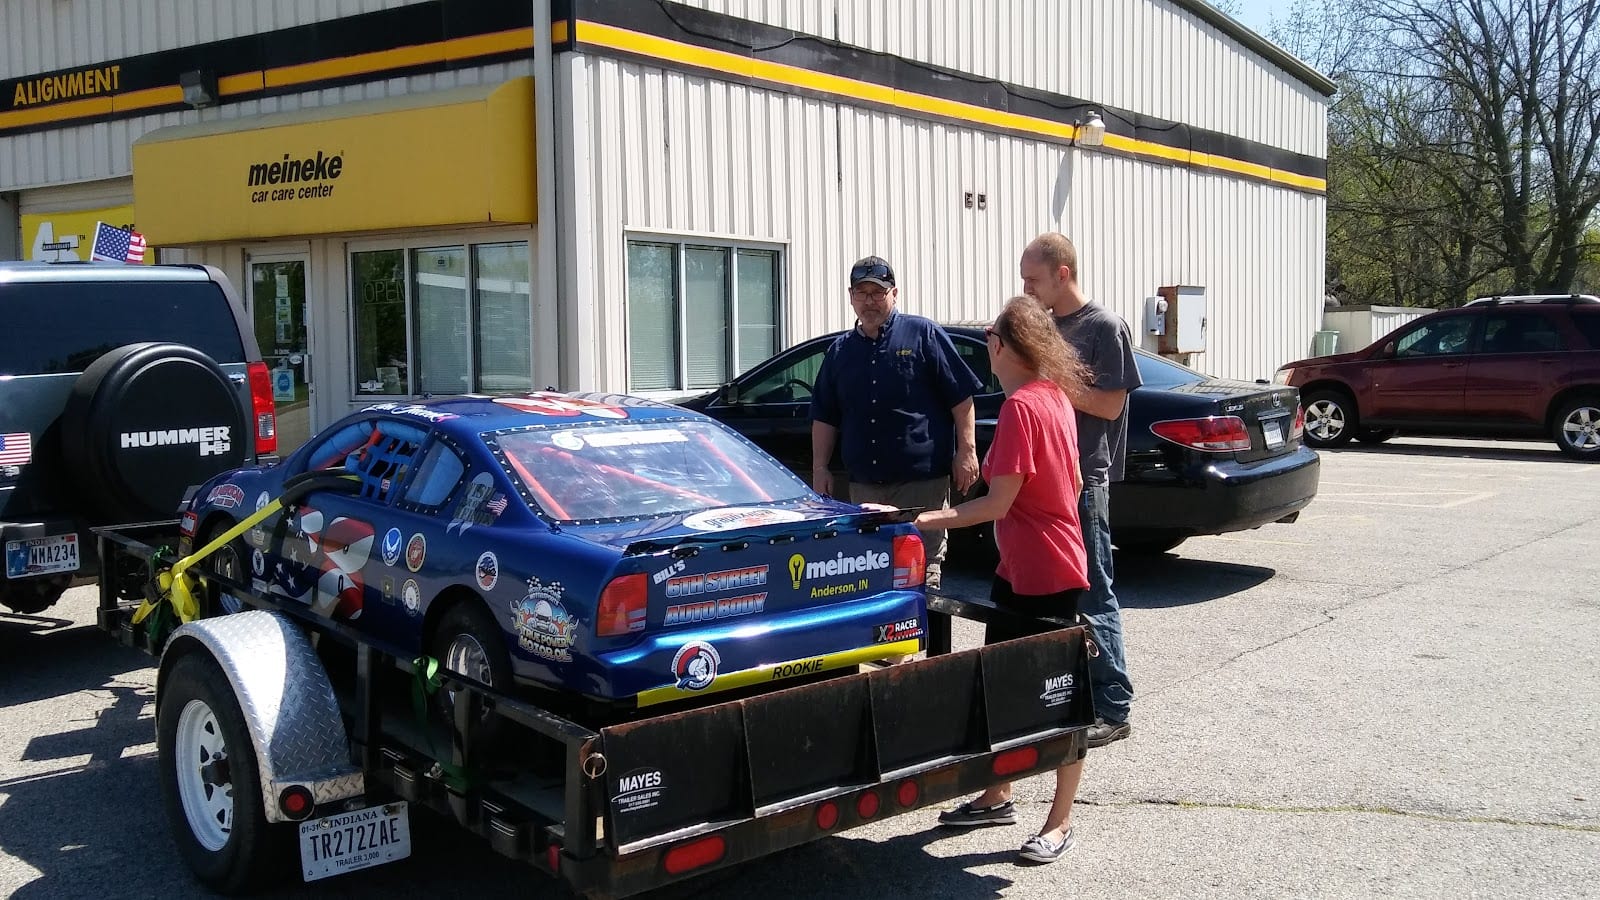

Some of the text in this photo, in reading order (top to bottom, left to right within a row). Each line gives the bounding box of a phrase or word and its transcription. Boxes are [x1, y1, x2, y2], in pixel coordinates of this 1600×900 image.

[13, 65, 120, 106] ALIGNMENT
[247, 150, 343, 186] meineke
[252, 182, 334, 203] car care center
[121, 426, 231, 448] HUMMER
[200, 441, 231, 456] H3
[653, 559, 686, 584] BILL'S
[806, 550, 889, 579] meineke
[665, 564, 769, 598] 6TH STREET
[811, 578, 869, 598] Anderson, IN
[664, 592, 768, 626] AUTO BODY
[895, 619, 918, 632] RACER
[772, 658, 824, 679] ROOKIE
[1045, 674, 1074, 690] MAYES
[619, 771, 661, 792] MAYES
[330, 811, 378, 828] INDIANA
[310, 817, 401, 861] TR272ZAE
[336, 855, 362, 867] TRAILER
